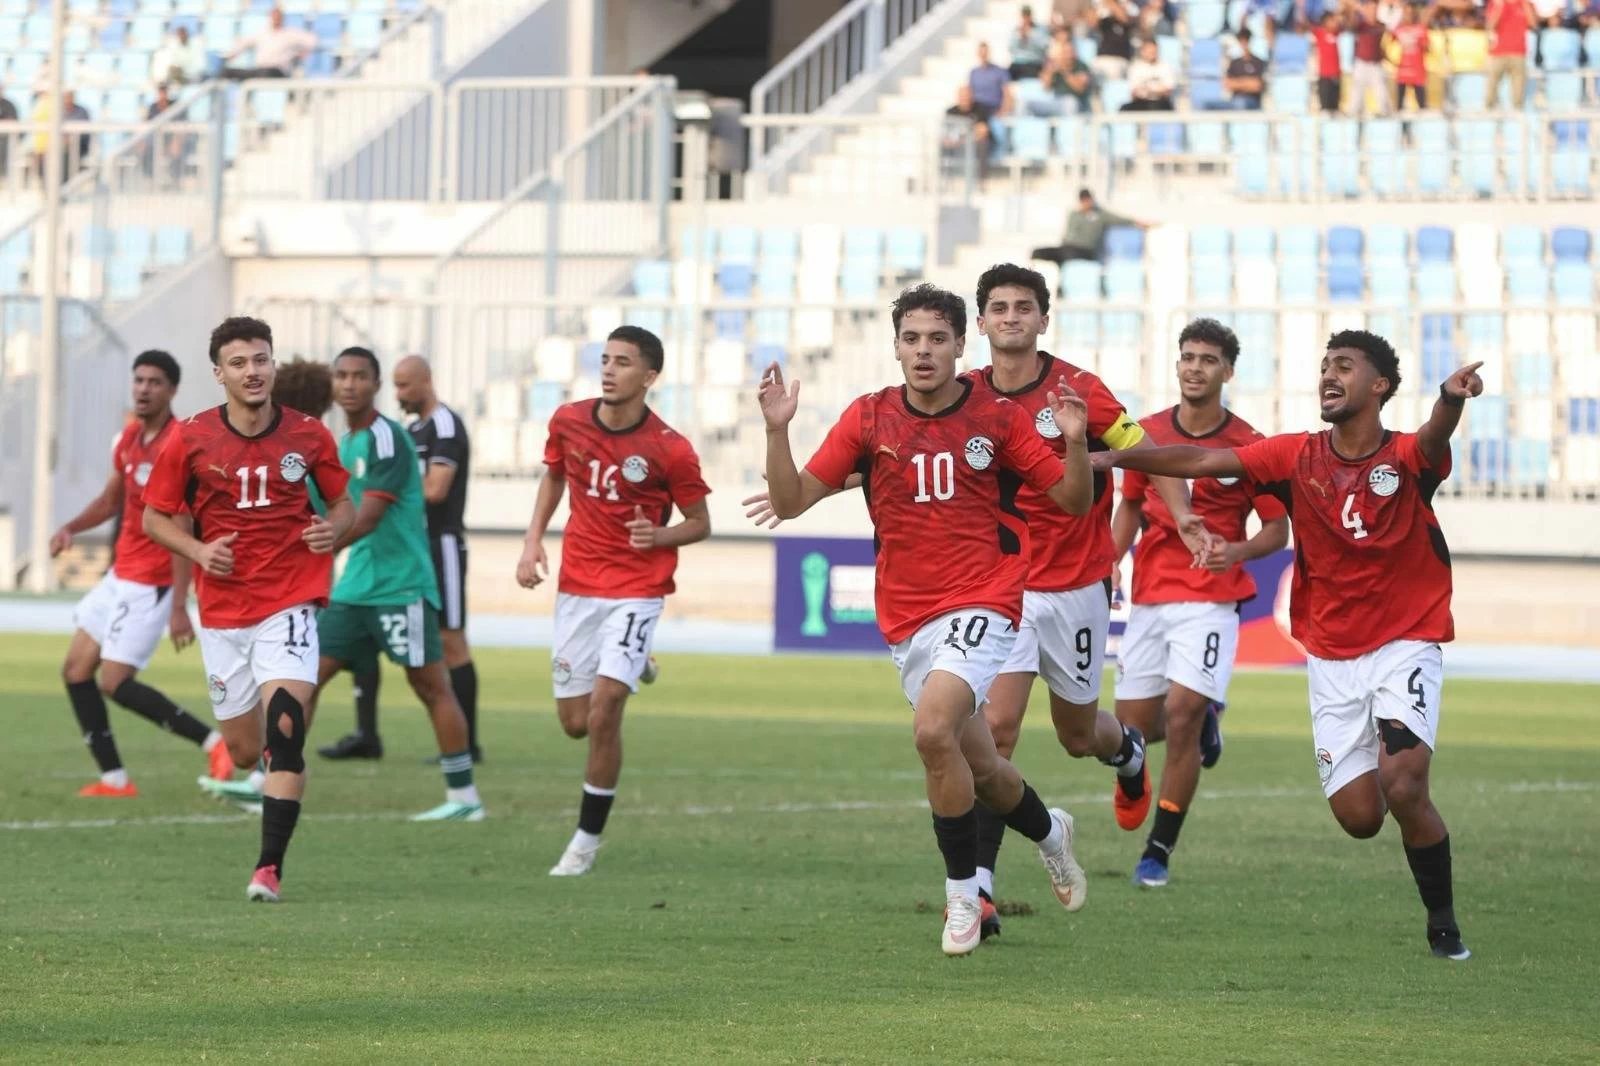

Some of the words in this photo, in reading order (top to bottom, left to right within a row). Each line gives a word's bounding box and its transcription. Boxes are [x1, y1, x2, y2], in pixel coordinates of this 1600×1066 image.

[236, 465, 271, 509] 11
[587, 459, 620, 501] 14
[911, 452, 955, 503] 10
[1341, 493, 1368, 539] 4
[111, 600, 129, 633] 2
[284, 609, 310, 647] 11
[944, 615, 989, 648] 10
[1075, 627, 1092, 671] 9
[1203, 632, 1220, 669] 8
[1407, 666, 1427, 709] 4
